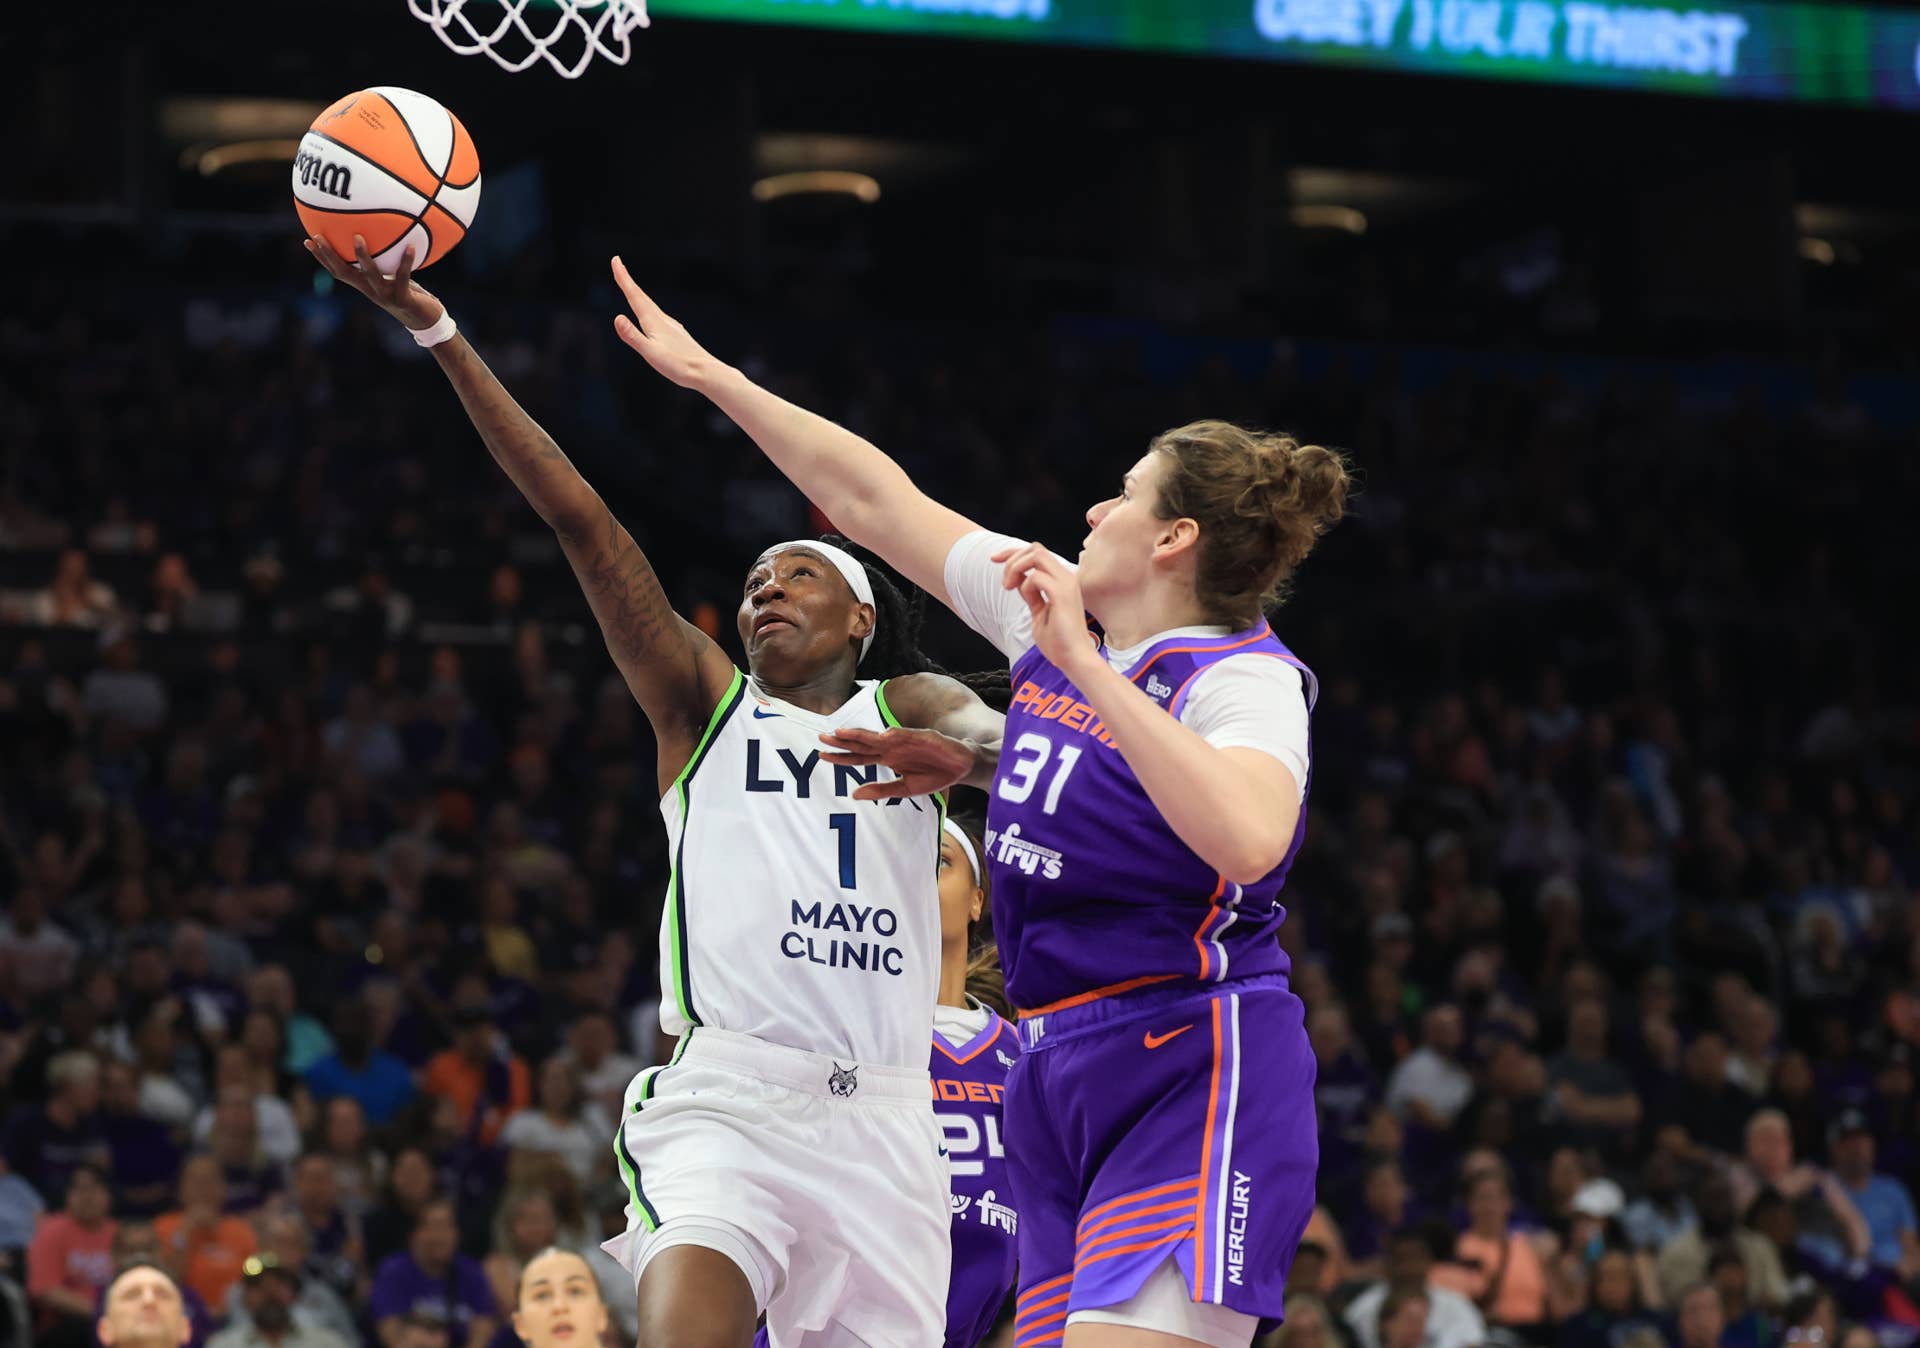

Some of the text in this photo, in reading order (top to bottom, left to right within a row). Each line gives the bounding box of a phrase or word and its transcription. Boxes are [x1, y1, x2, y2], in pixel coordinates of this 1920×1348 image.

[1253, 0, 1397, 47] OBEY
[1563, 2, 1749, 77] THIRST
[745, 739, 924, 812] LYN
[998, 732, 1083, 815] 31
[829, 813, 857, 890] 1
[997, 822, 1063, 880] fry's
[780, 931, 904, 976] CLINIC
[791, 898, 897, 937] MAYO
[1228, 1170, 1252, 1286] MERCURY
